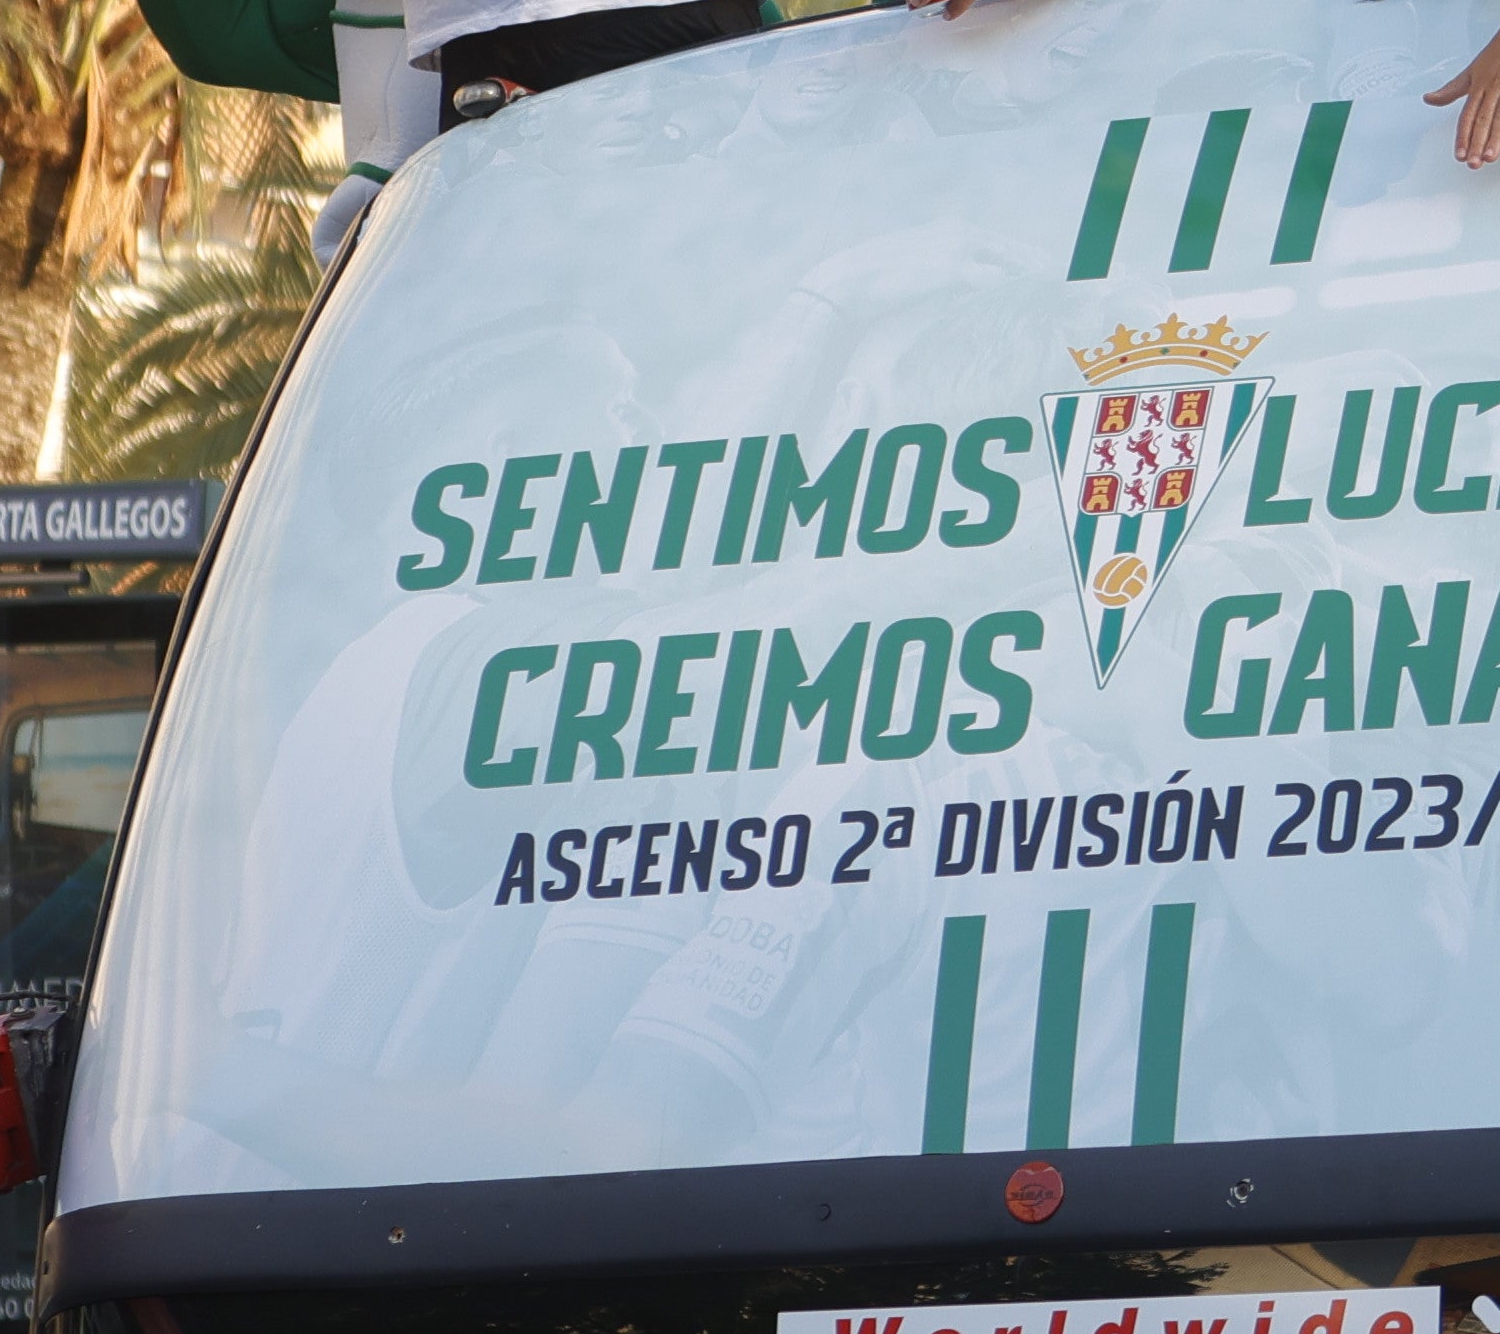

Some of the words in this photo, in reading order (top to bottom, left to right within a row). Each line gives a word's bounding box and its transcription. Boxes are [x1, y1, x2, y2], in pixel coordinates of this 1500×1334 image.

[45, 496, 187, 541] GALLEGOS
[395, 416, 1033, 592] SENTIMOS
[462, 610, 1045, 790] CREIMOS
[494, 813, 812, 905] ASCENSO
[831, 806, 915, 885] 2ª
[934, 771, 1243, 877] DIVISIÓN
